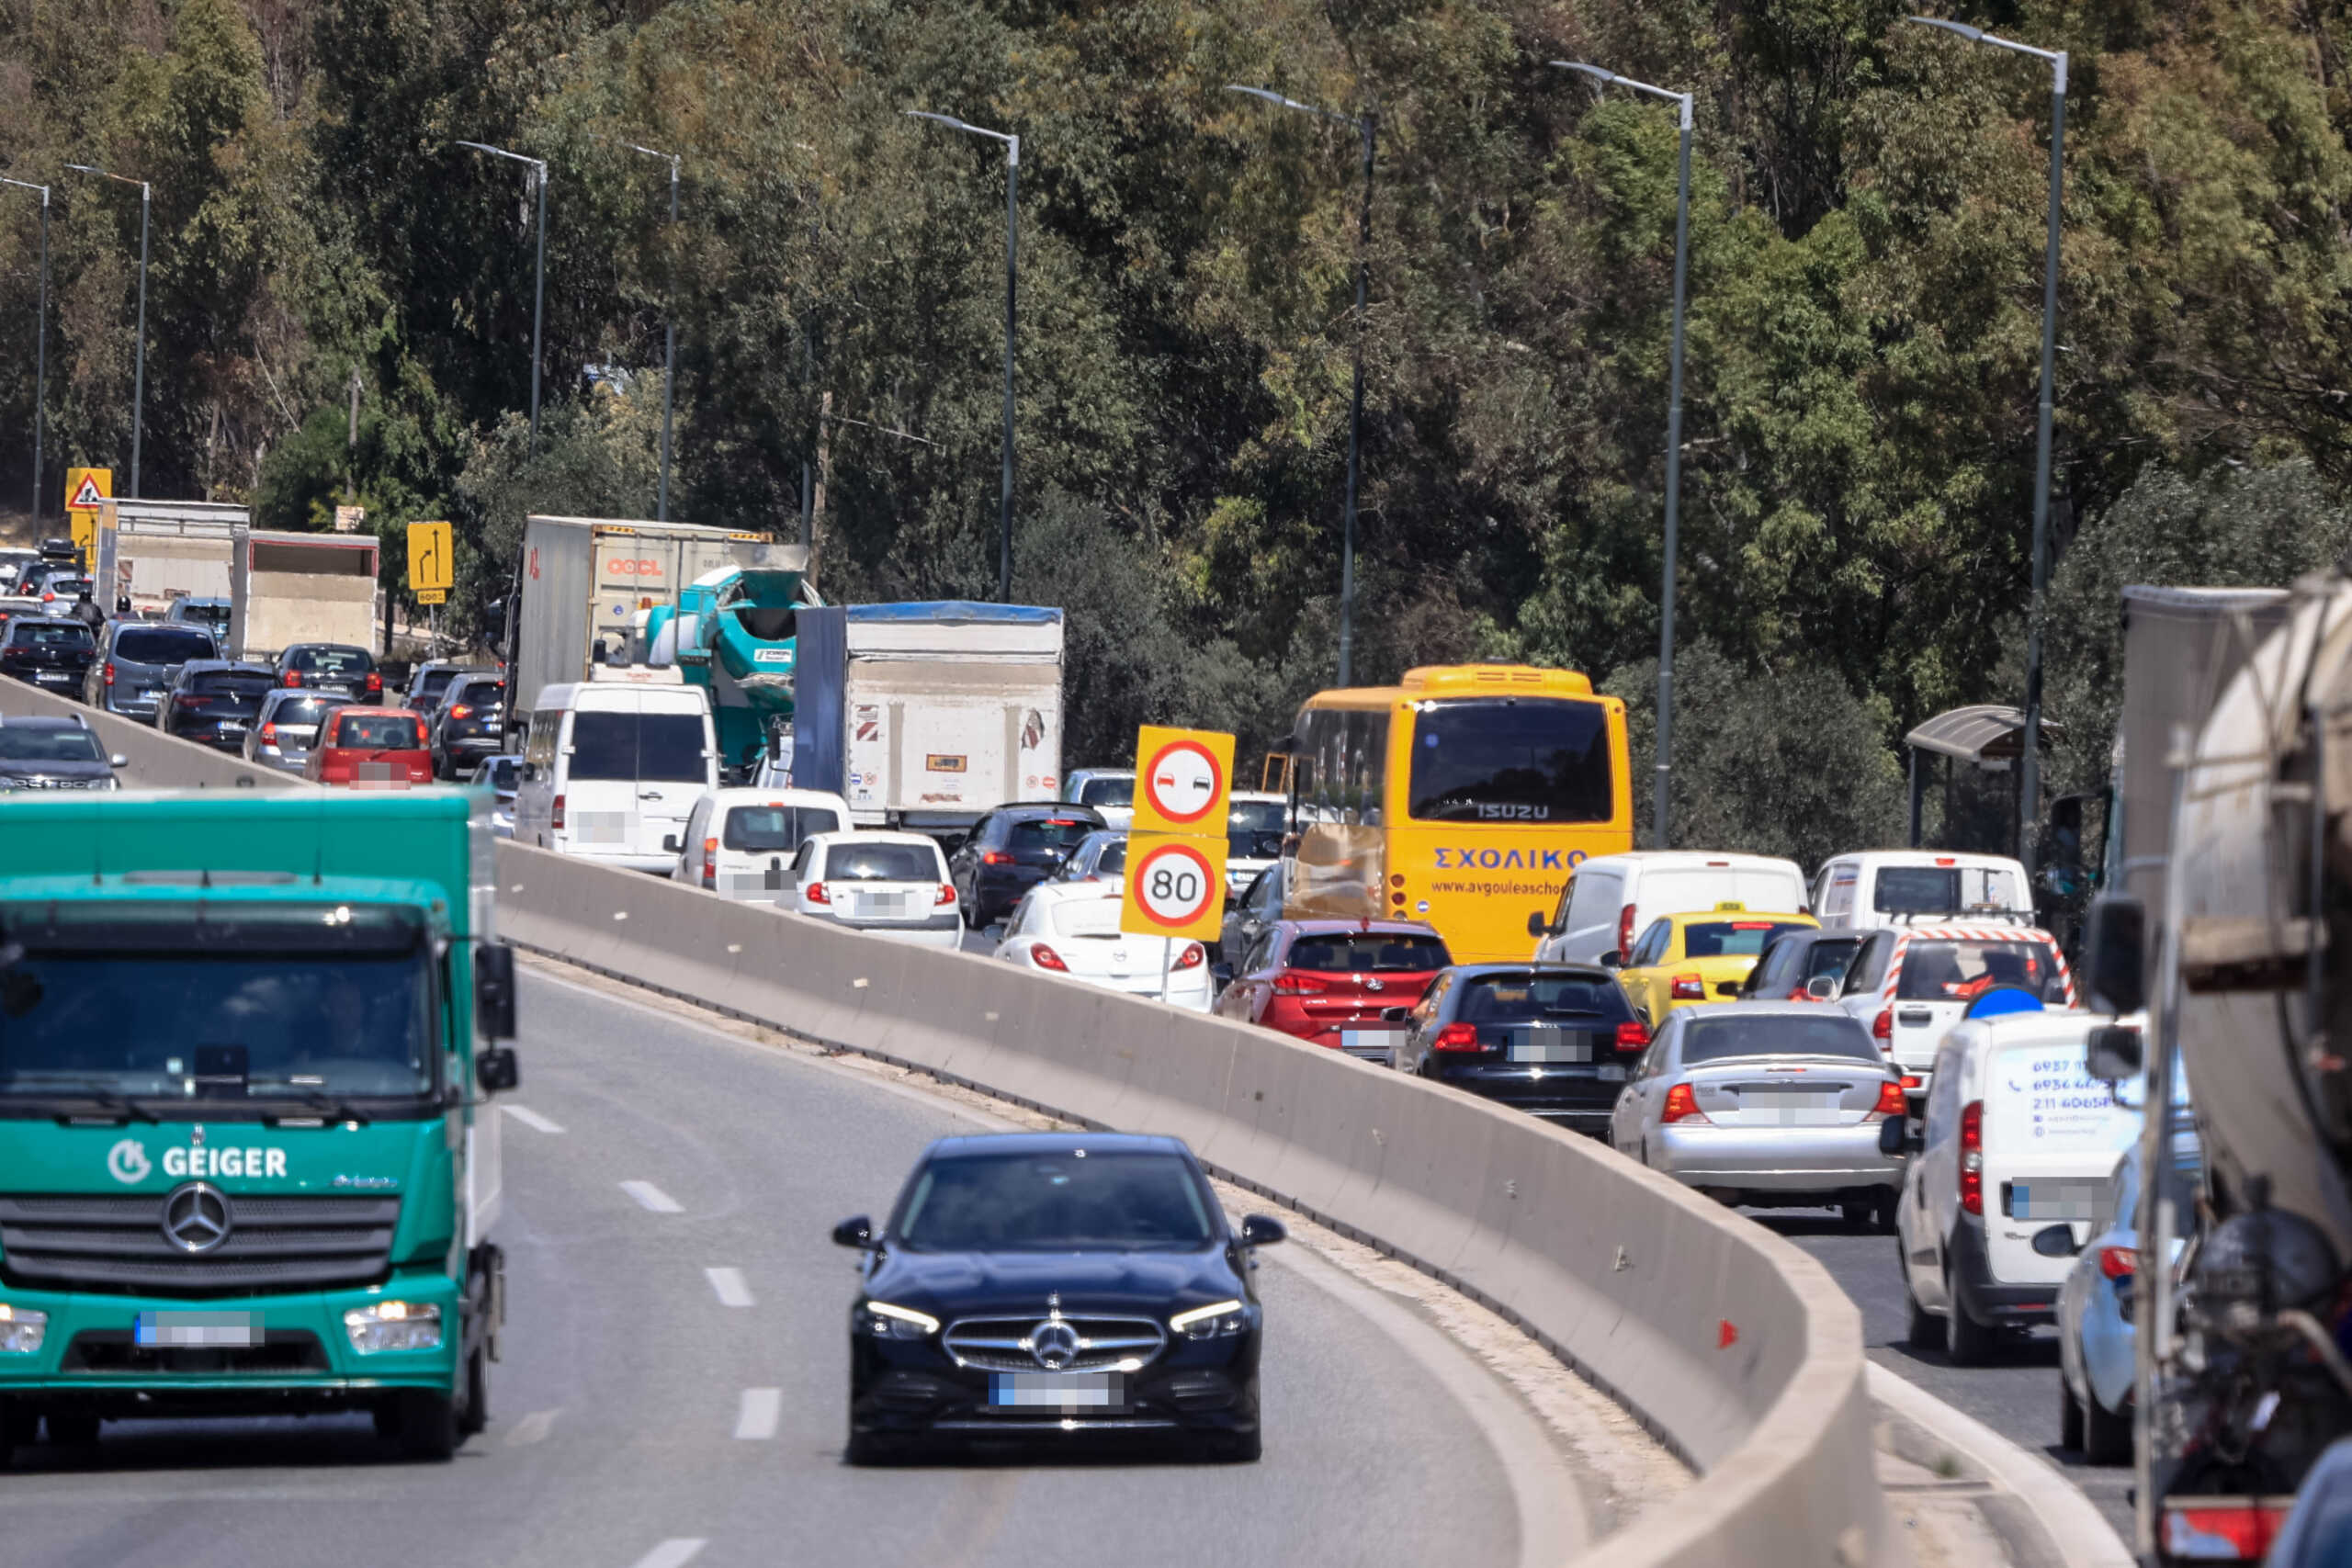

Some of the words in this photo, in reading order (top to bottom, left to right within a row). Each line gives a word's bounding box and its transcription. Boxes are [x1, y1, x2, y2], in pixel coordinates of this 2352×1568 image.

[1478, 804, 1548, 818] ISUZU
[1434, 848, 1588, 869] ΣΧΟΛΙΚΟ
[1152, 870, 1197, 902] 80
[2033, 1098, 2056, 1111] 211
[162, 1147, 287, 1178] GEIGER
